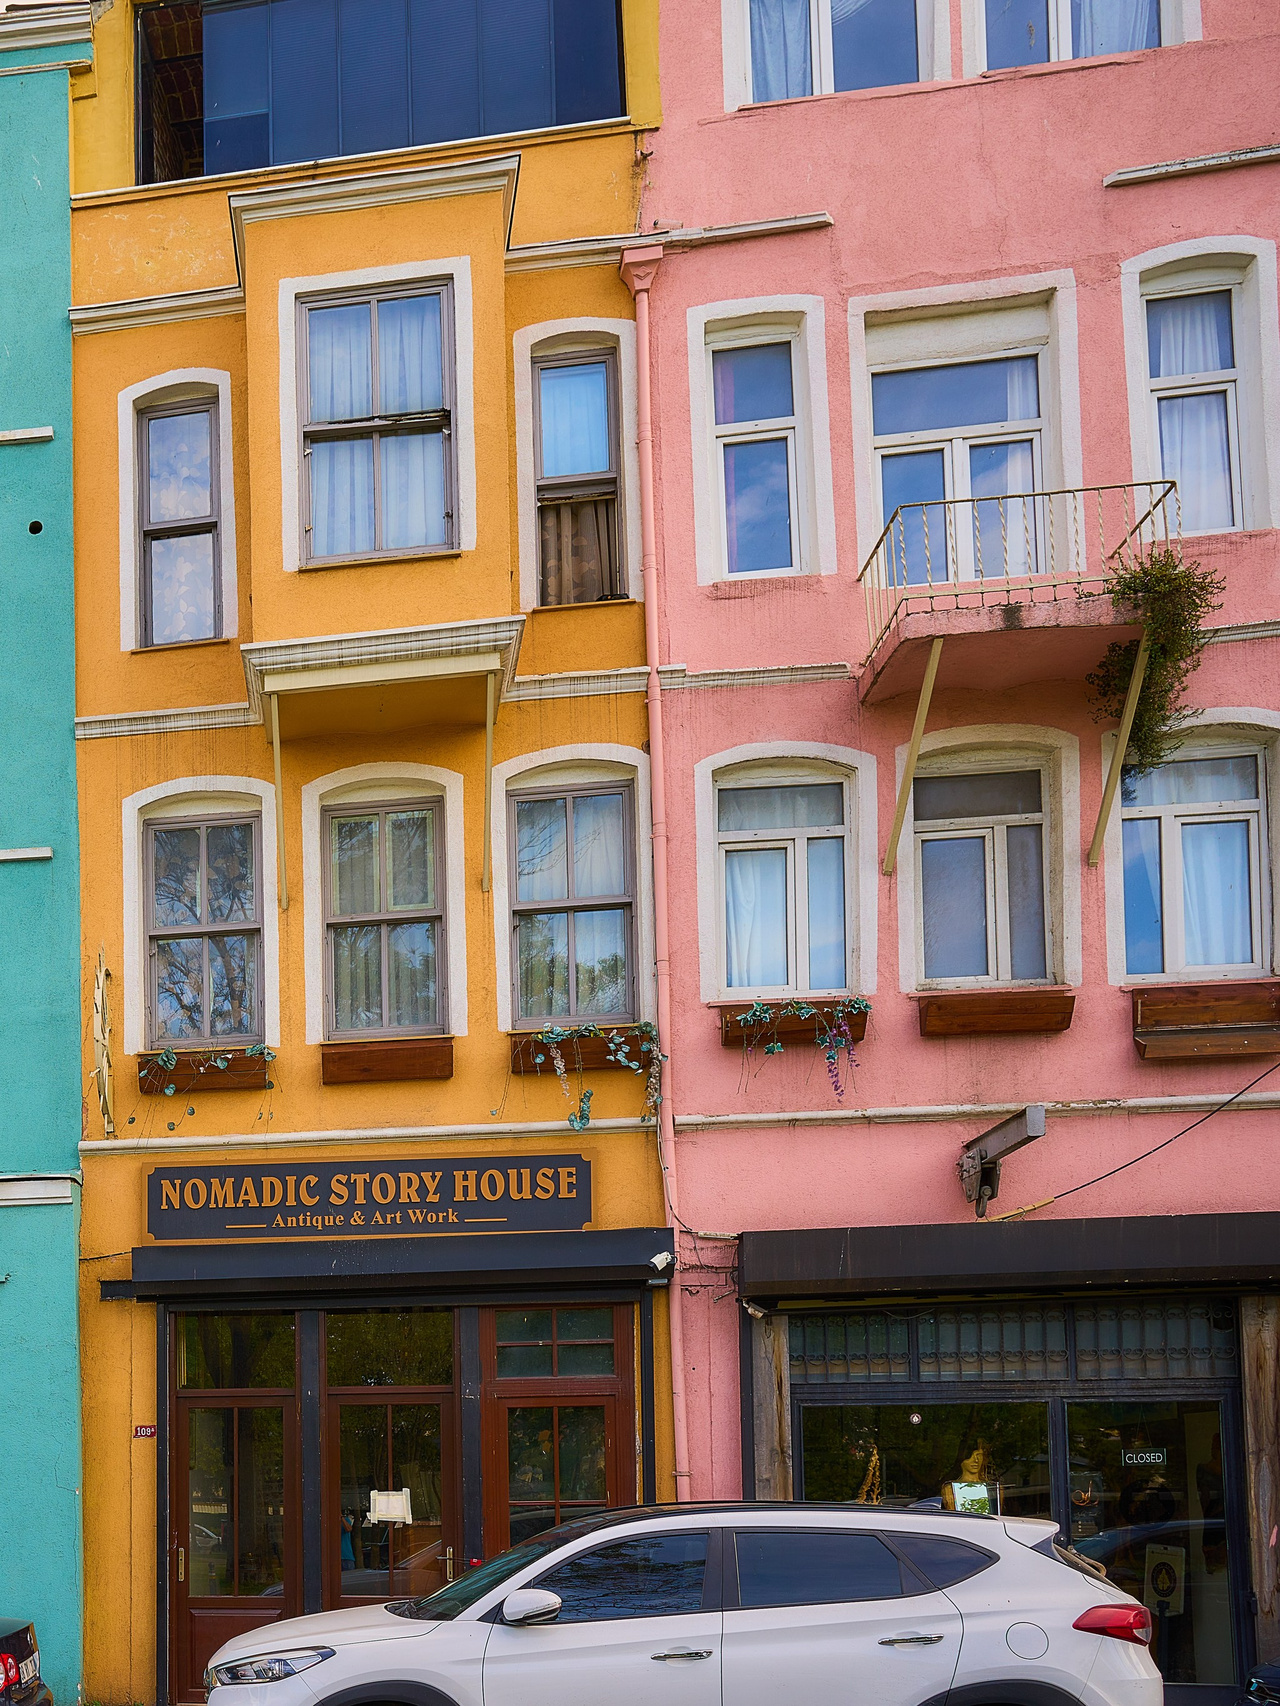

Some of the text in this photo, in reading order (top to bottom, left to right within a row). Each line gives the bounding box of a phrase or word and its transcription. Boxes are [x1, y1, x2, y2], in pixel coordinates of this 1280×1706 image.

[160, 1167, 577, 1210] NOMADIC STORY HOUSE
[271, 1208, 460, 1231] Antique & Art Work
[1125, 1452, 1163, 1464] CLOSED
